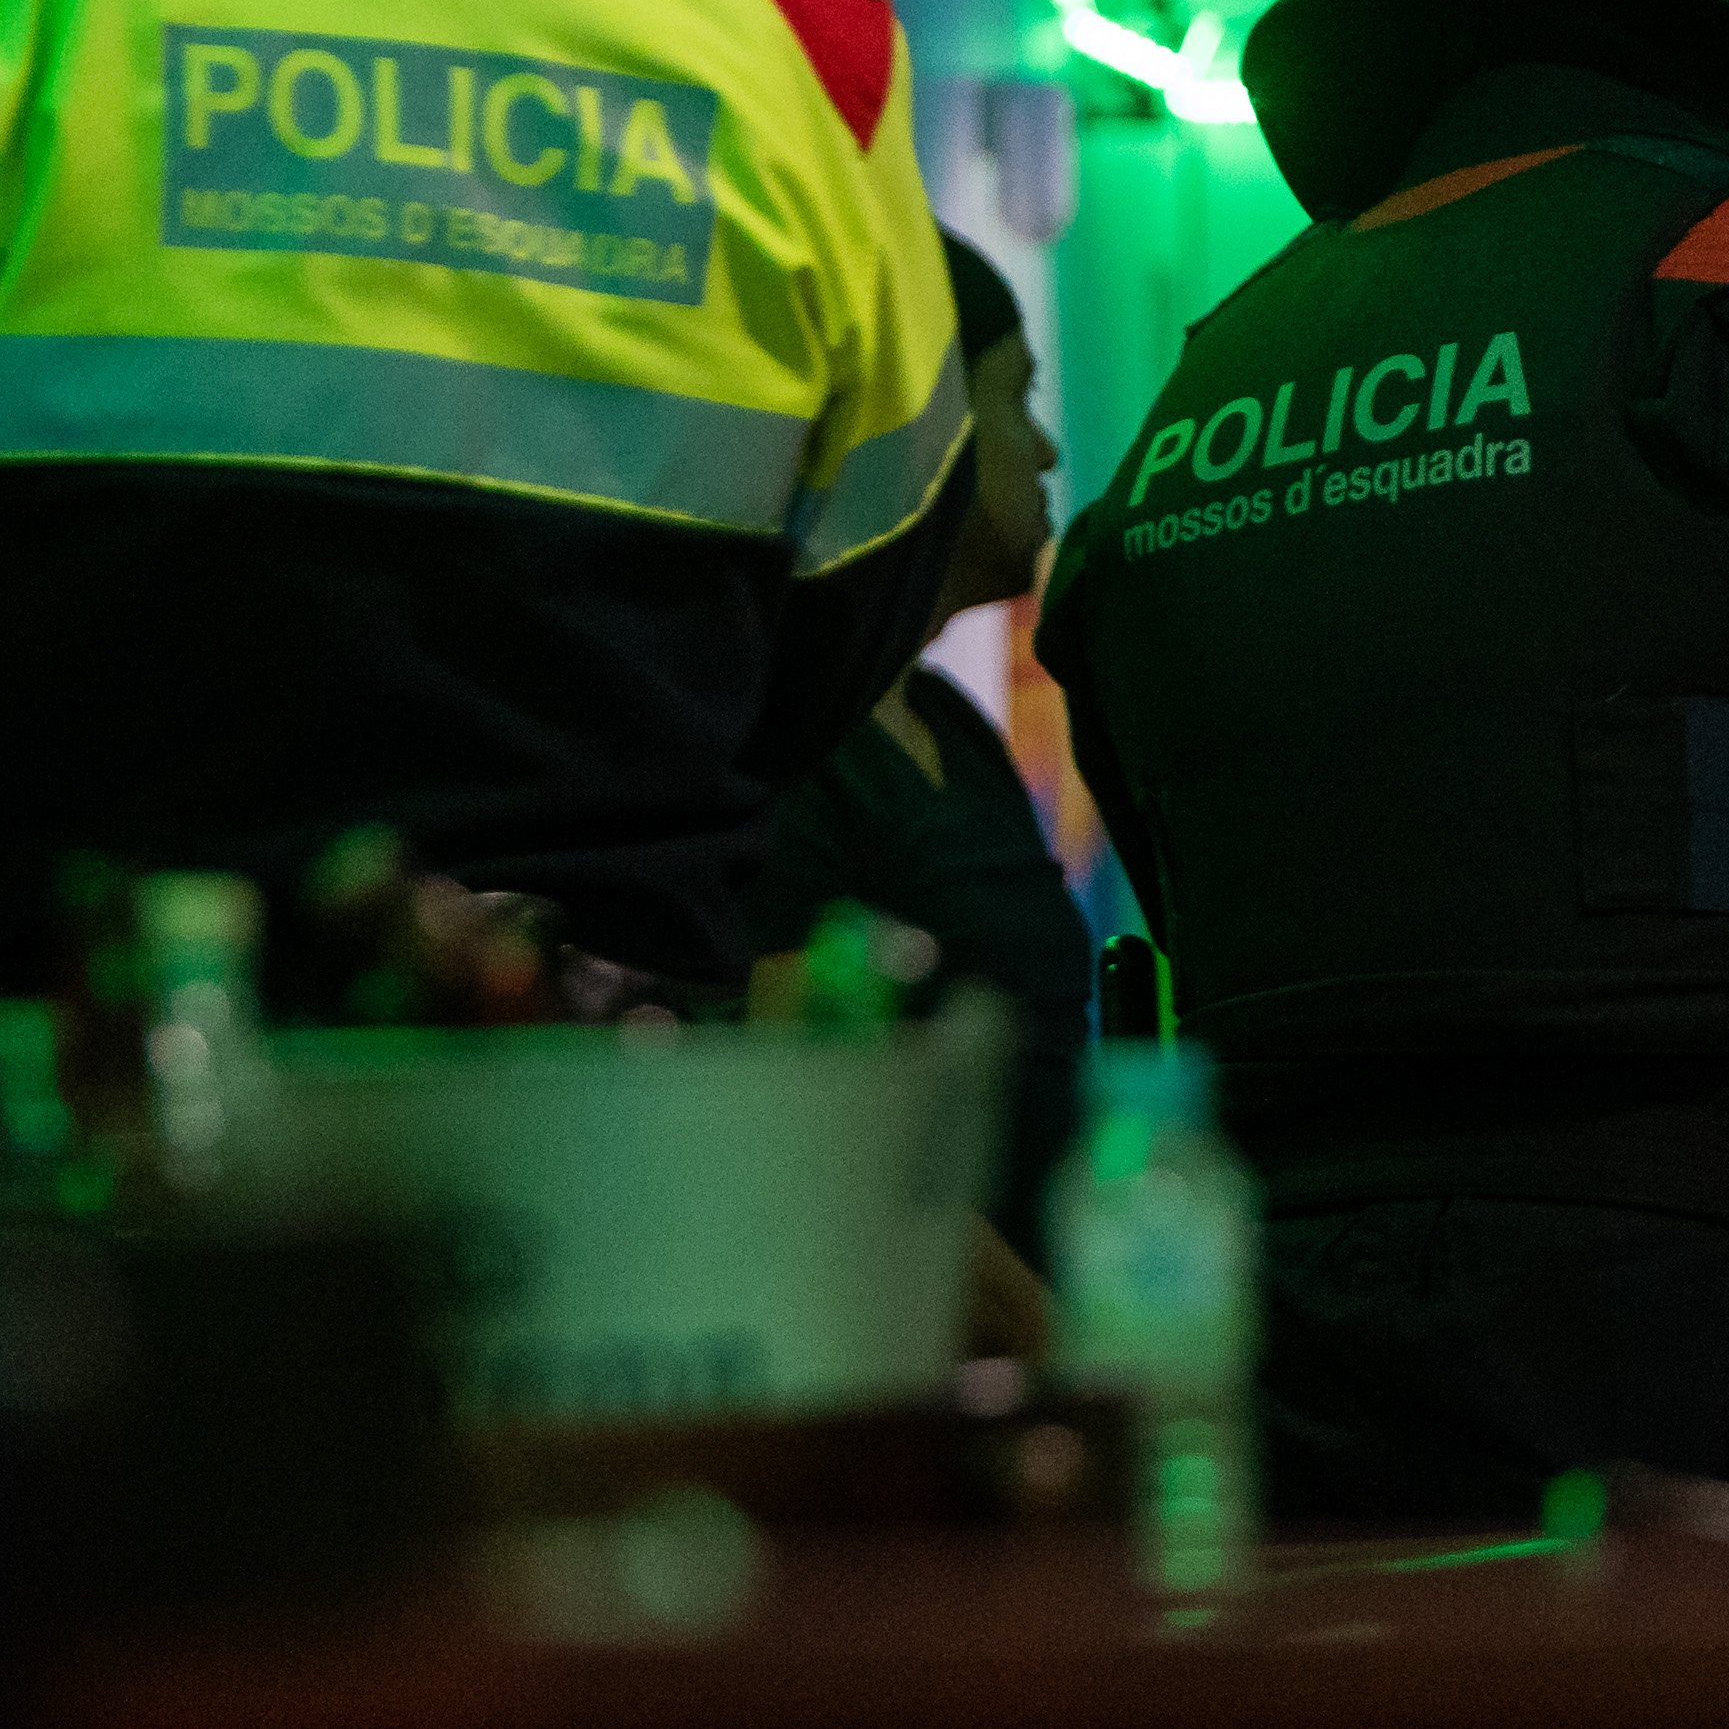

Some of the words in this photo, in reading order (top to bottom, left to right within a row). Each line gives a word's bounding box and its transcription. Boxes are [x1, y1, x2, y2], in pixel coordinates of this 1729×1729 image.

[182, 43, 695, 204] POLICIA
[1127, 331, 1532, 508] POLICIA
[1122, 487, 1273, 561] mossos
